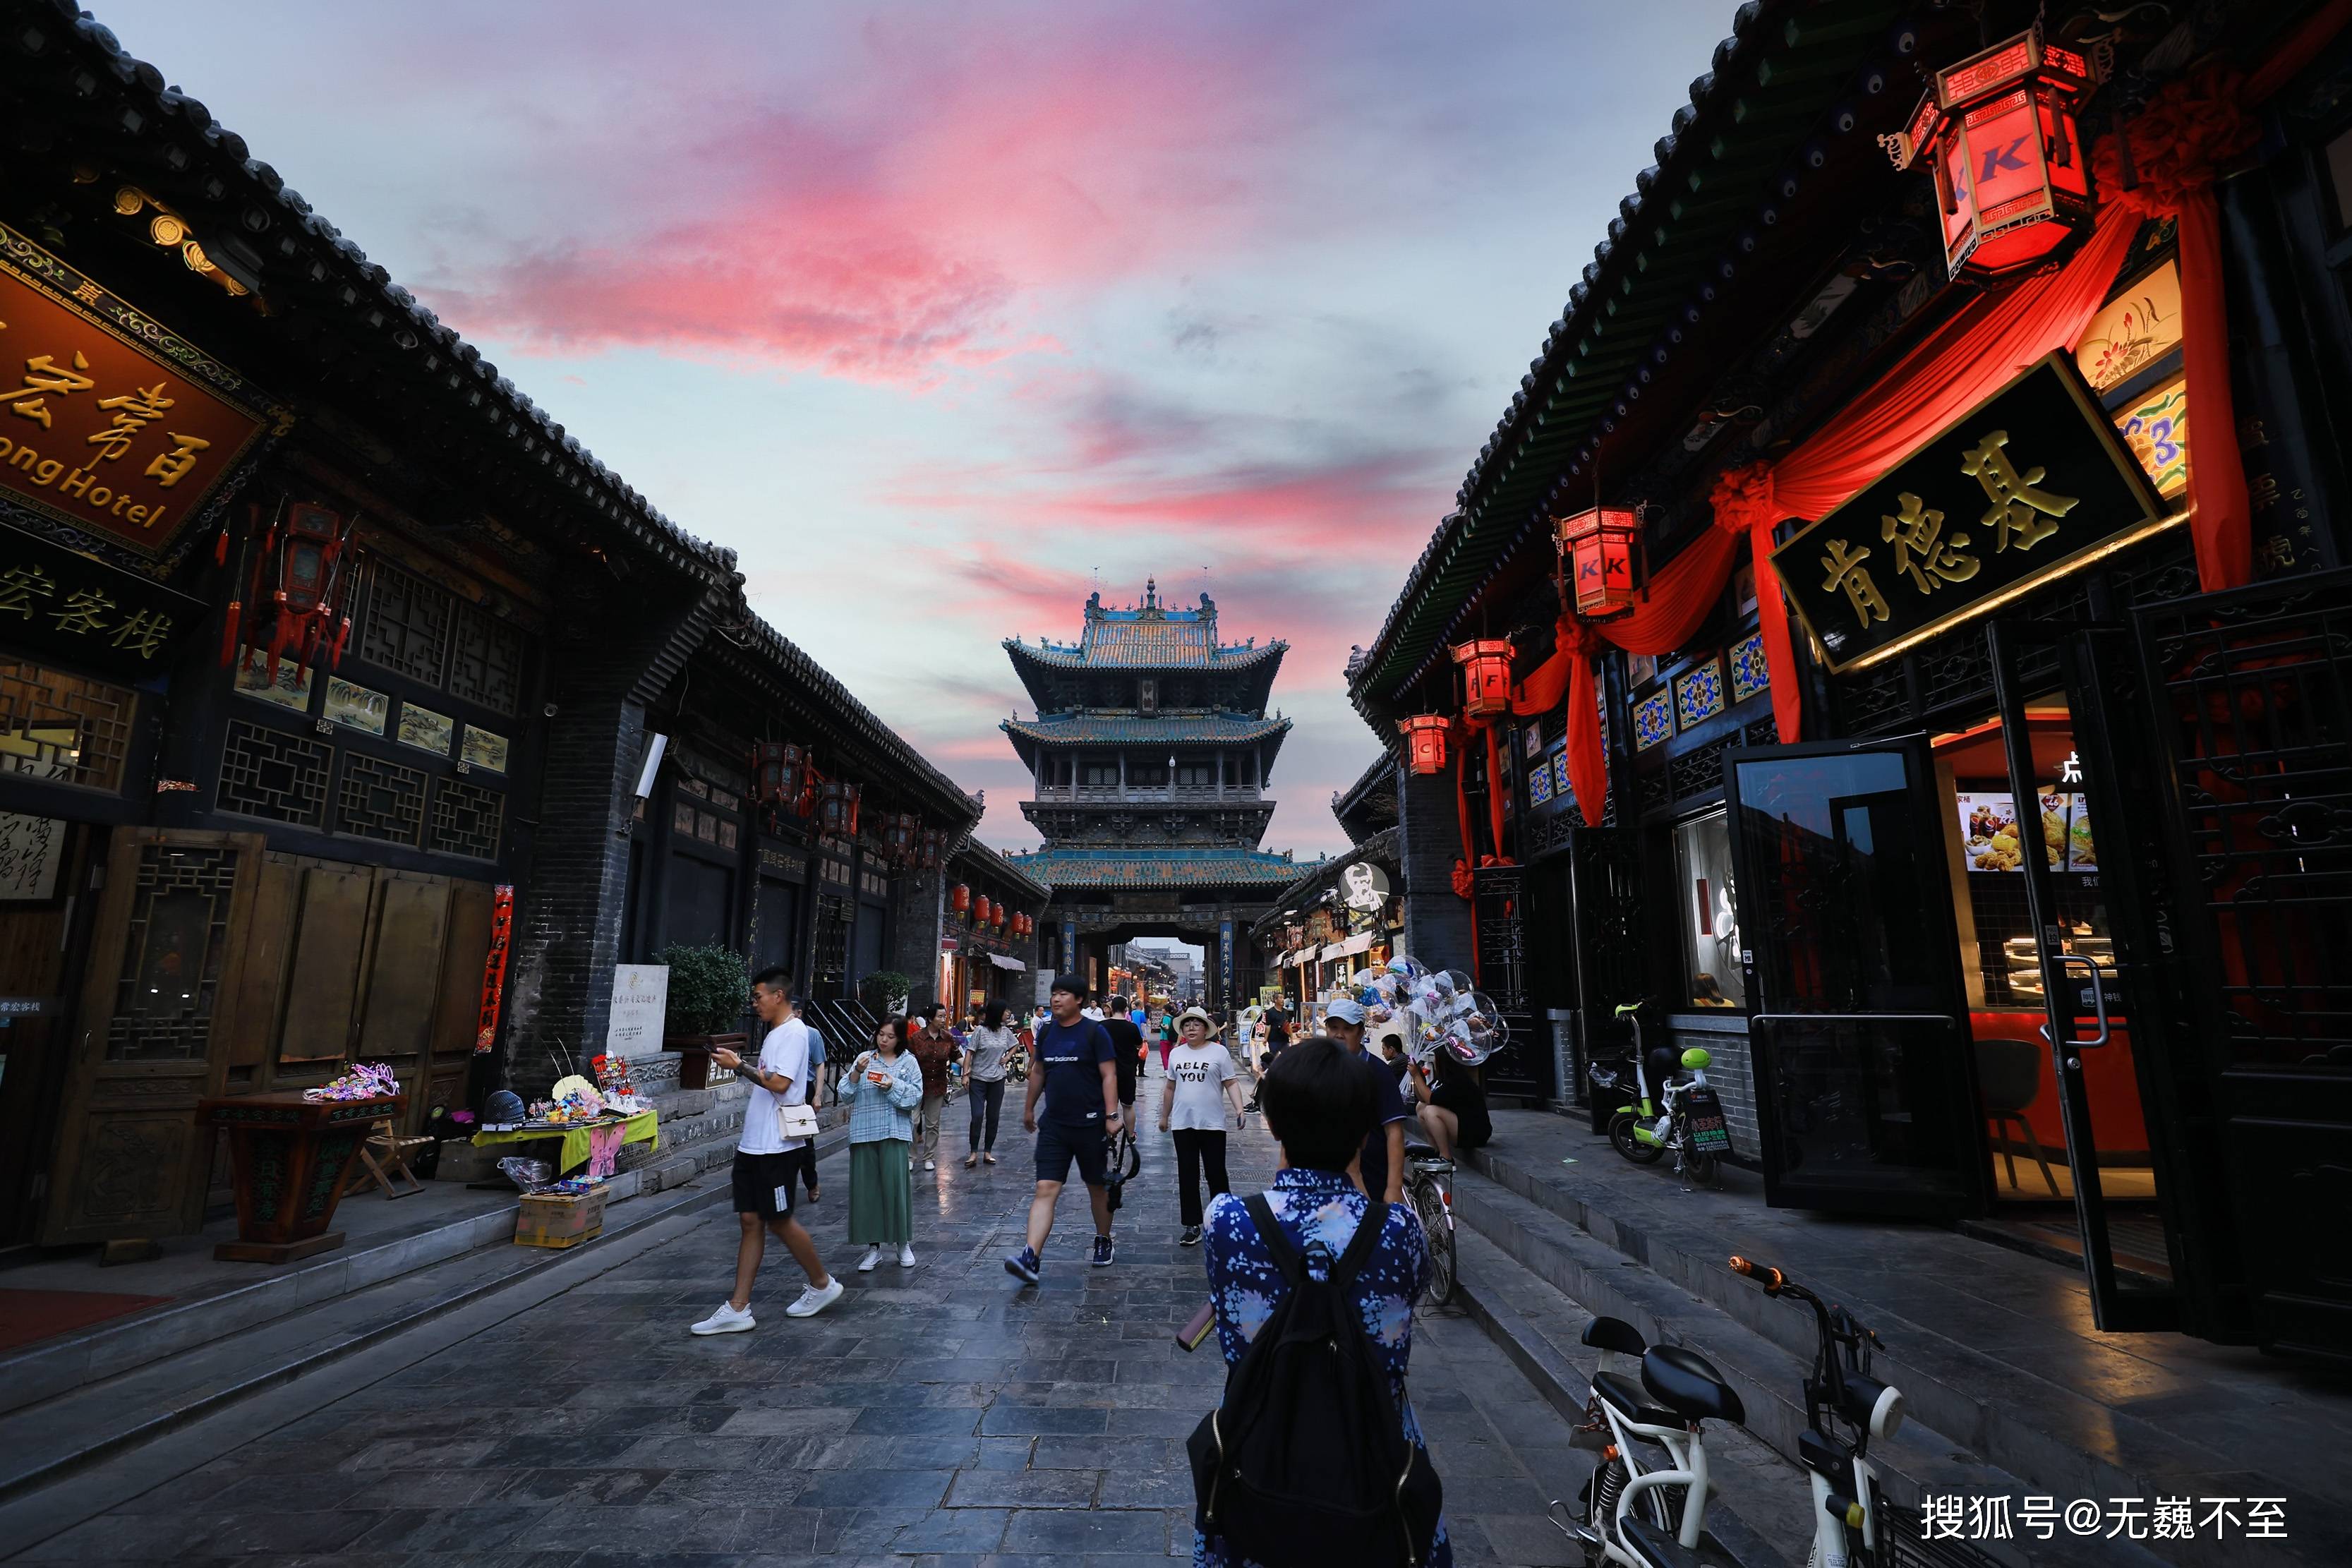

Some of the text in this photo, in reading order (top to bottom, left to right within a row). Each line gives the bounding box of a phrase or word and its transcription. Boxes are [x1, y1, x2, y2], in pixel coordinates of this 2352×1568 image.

[1976, 132, 2033, 183] K
[1821, 428, 2080, 629] 肯德基
[1580, 557, 1626, 582] K K
[0, 563, 174, 661] 宏客栈
[1486, 675, 1498, 687] F
[1420, 743, 1431, 753] C
[2049, 934, 2058, 943] 拉
[1, 1001, 40, 1012] 常宏客栈
[1175, 1061, 1210, 1072] ABLE
[1179, 1072, 1205, 1082] YOU
